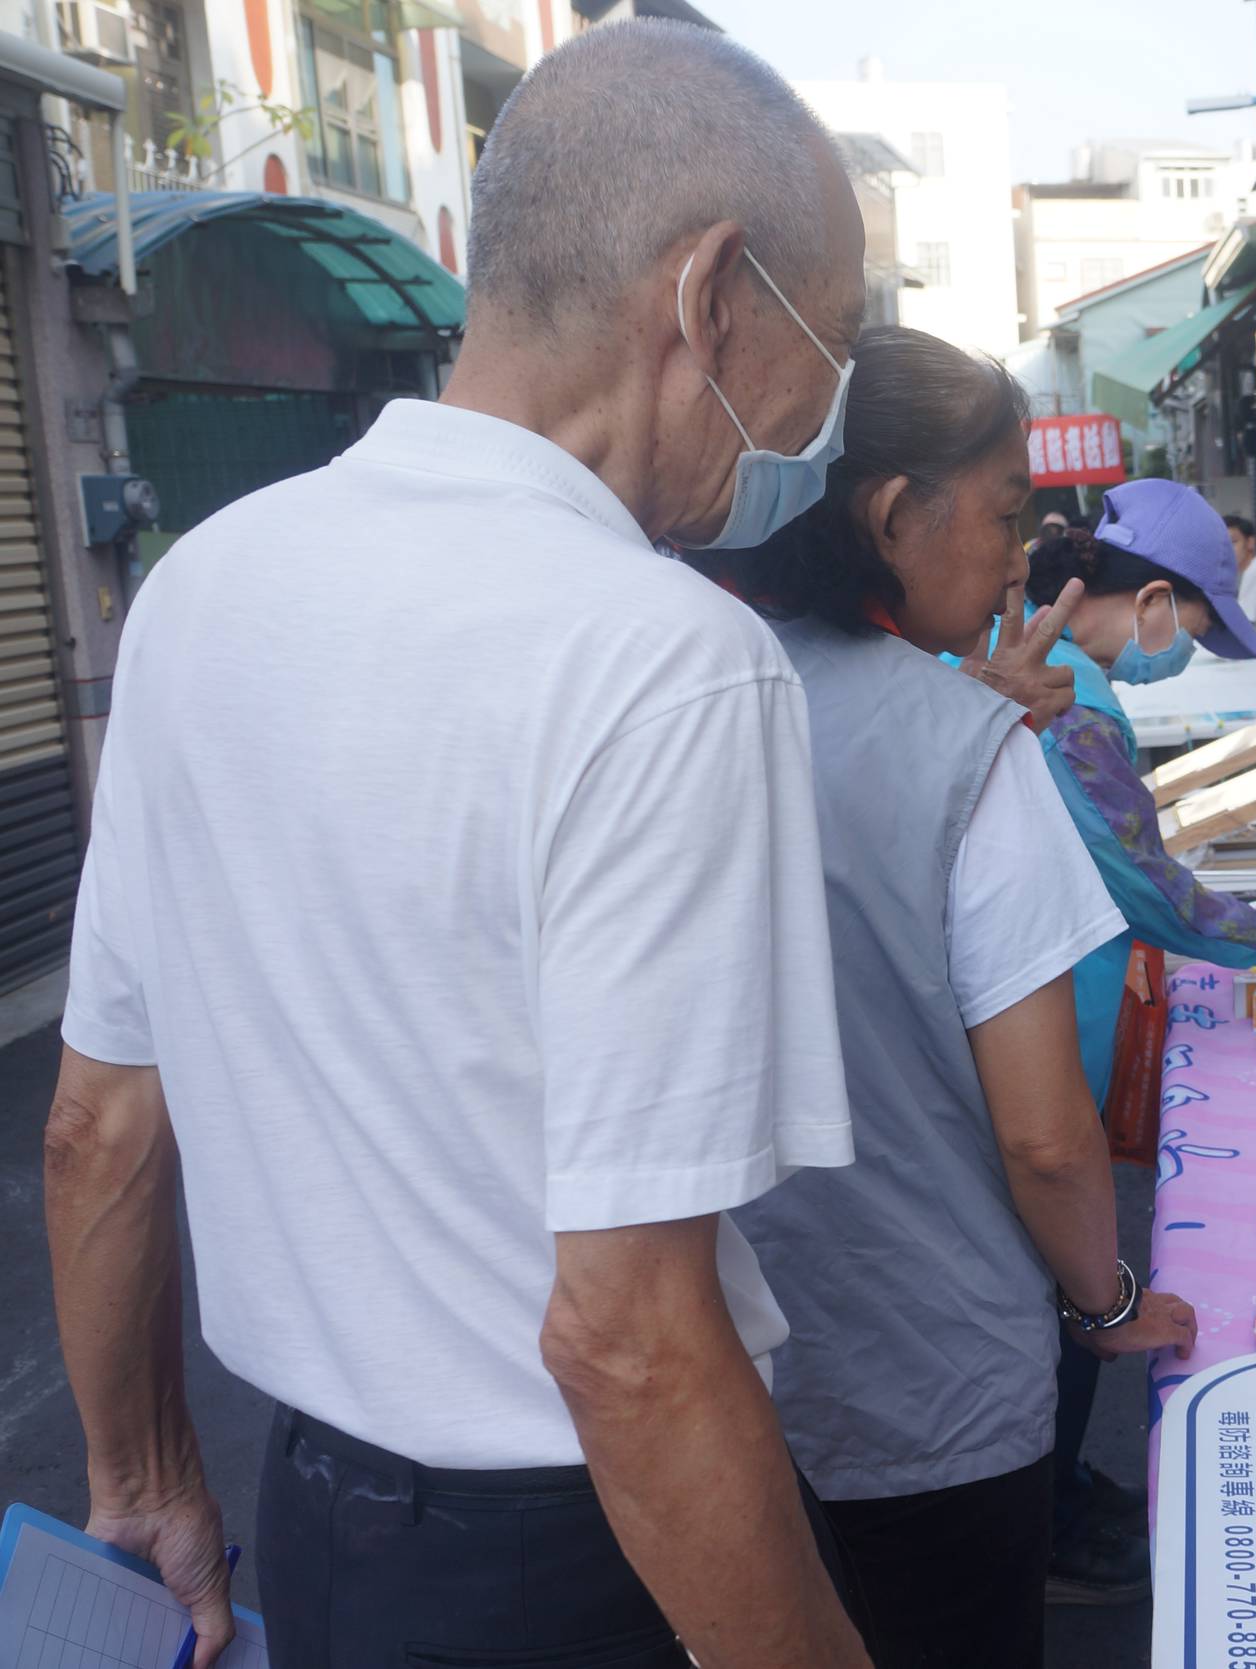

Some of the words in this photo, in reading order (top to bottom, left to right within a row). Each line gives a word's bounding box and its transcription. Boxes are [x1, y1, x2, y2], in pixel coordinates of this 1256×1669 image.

[1218, 1410, 1256, 1518] 毒防諮詢專線
